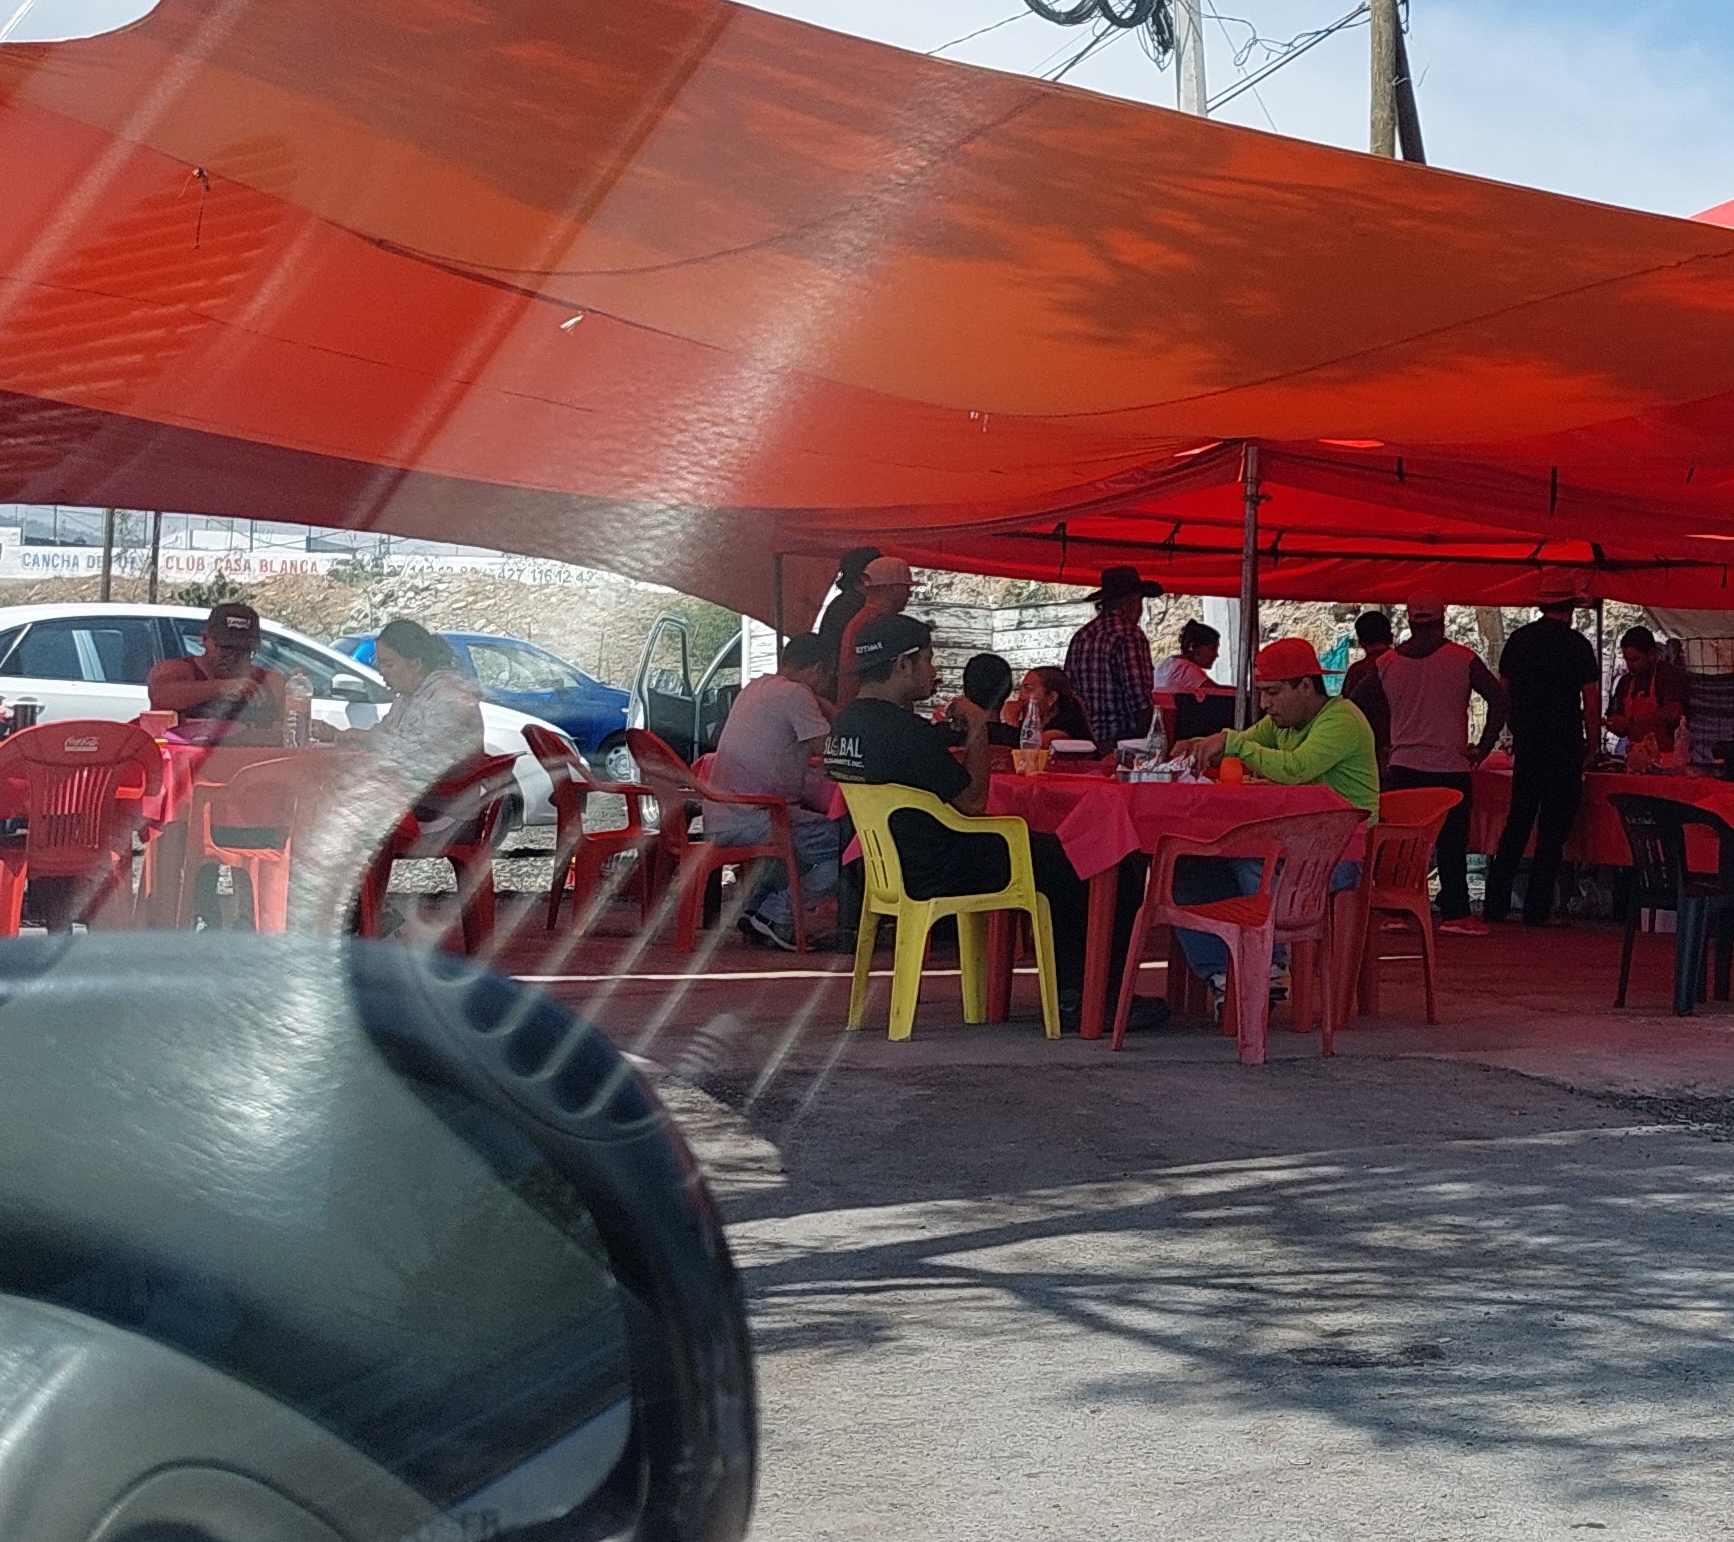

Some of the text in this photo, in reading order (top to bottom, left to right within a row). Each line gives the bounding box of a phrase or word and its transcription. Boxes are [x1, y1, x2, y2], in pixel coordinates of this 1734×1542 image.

[22, 552, 80, 570] CANCHA
[165, 555, 319, 575] CLUB CASA BLANCA
